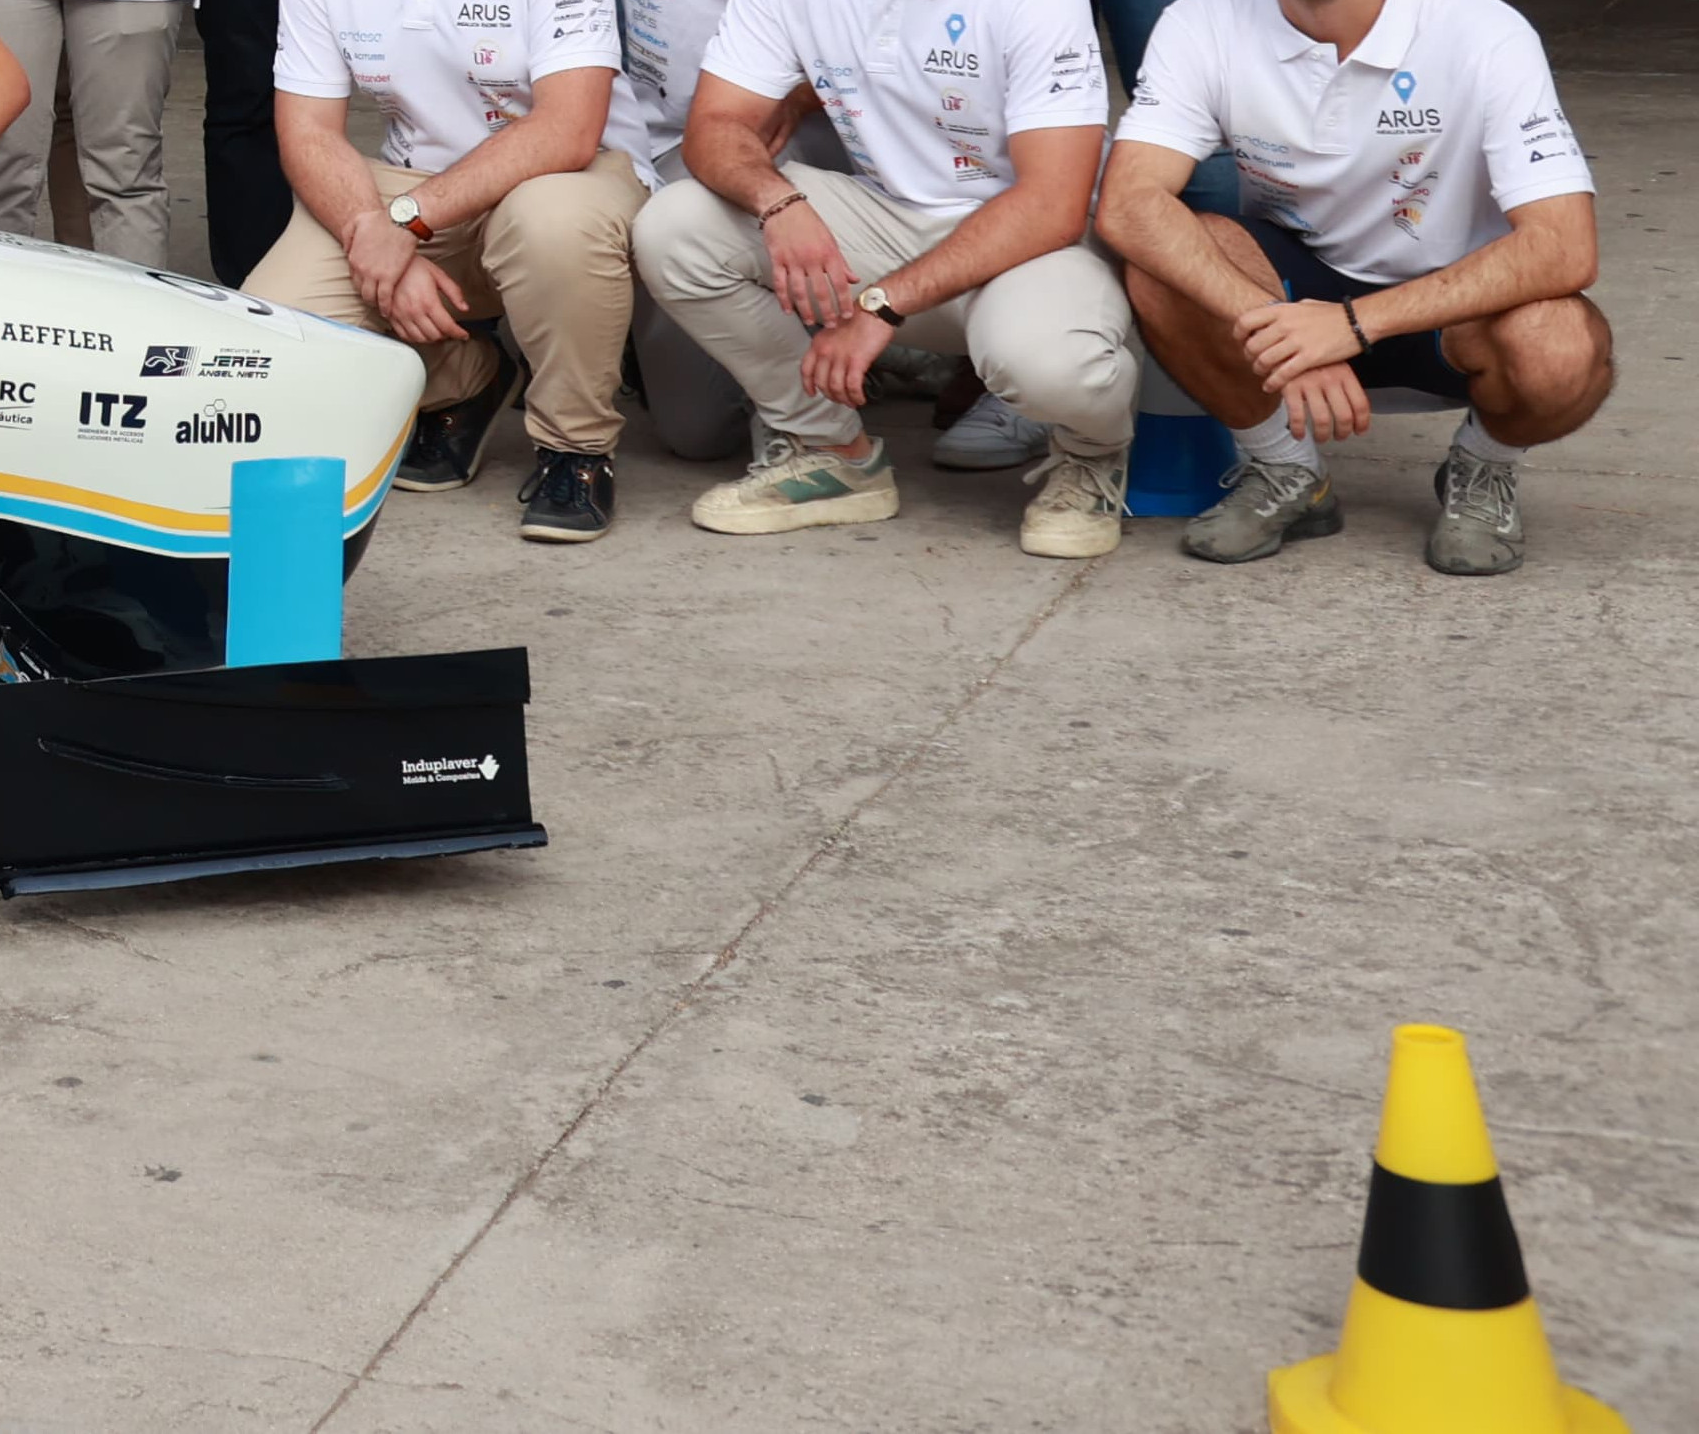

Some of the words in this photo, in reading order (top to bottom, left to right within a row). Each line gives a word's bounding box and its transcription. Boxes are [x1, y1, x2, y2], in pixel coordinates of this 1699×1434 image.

[458, 3, 511, 21] ARUS
[925, 49, 979, 71] ARUS
[1377, 108, 1441, 128] ARUS
[201, 355, 272, 369] JEREZ
[79, 391, 148, 429] ITZ
[176, 413, 262, 444] aluNID
[402, 757, 478, 774] Induplaver
